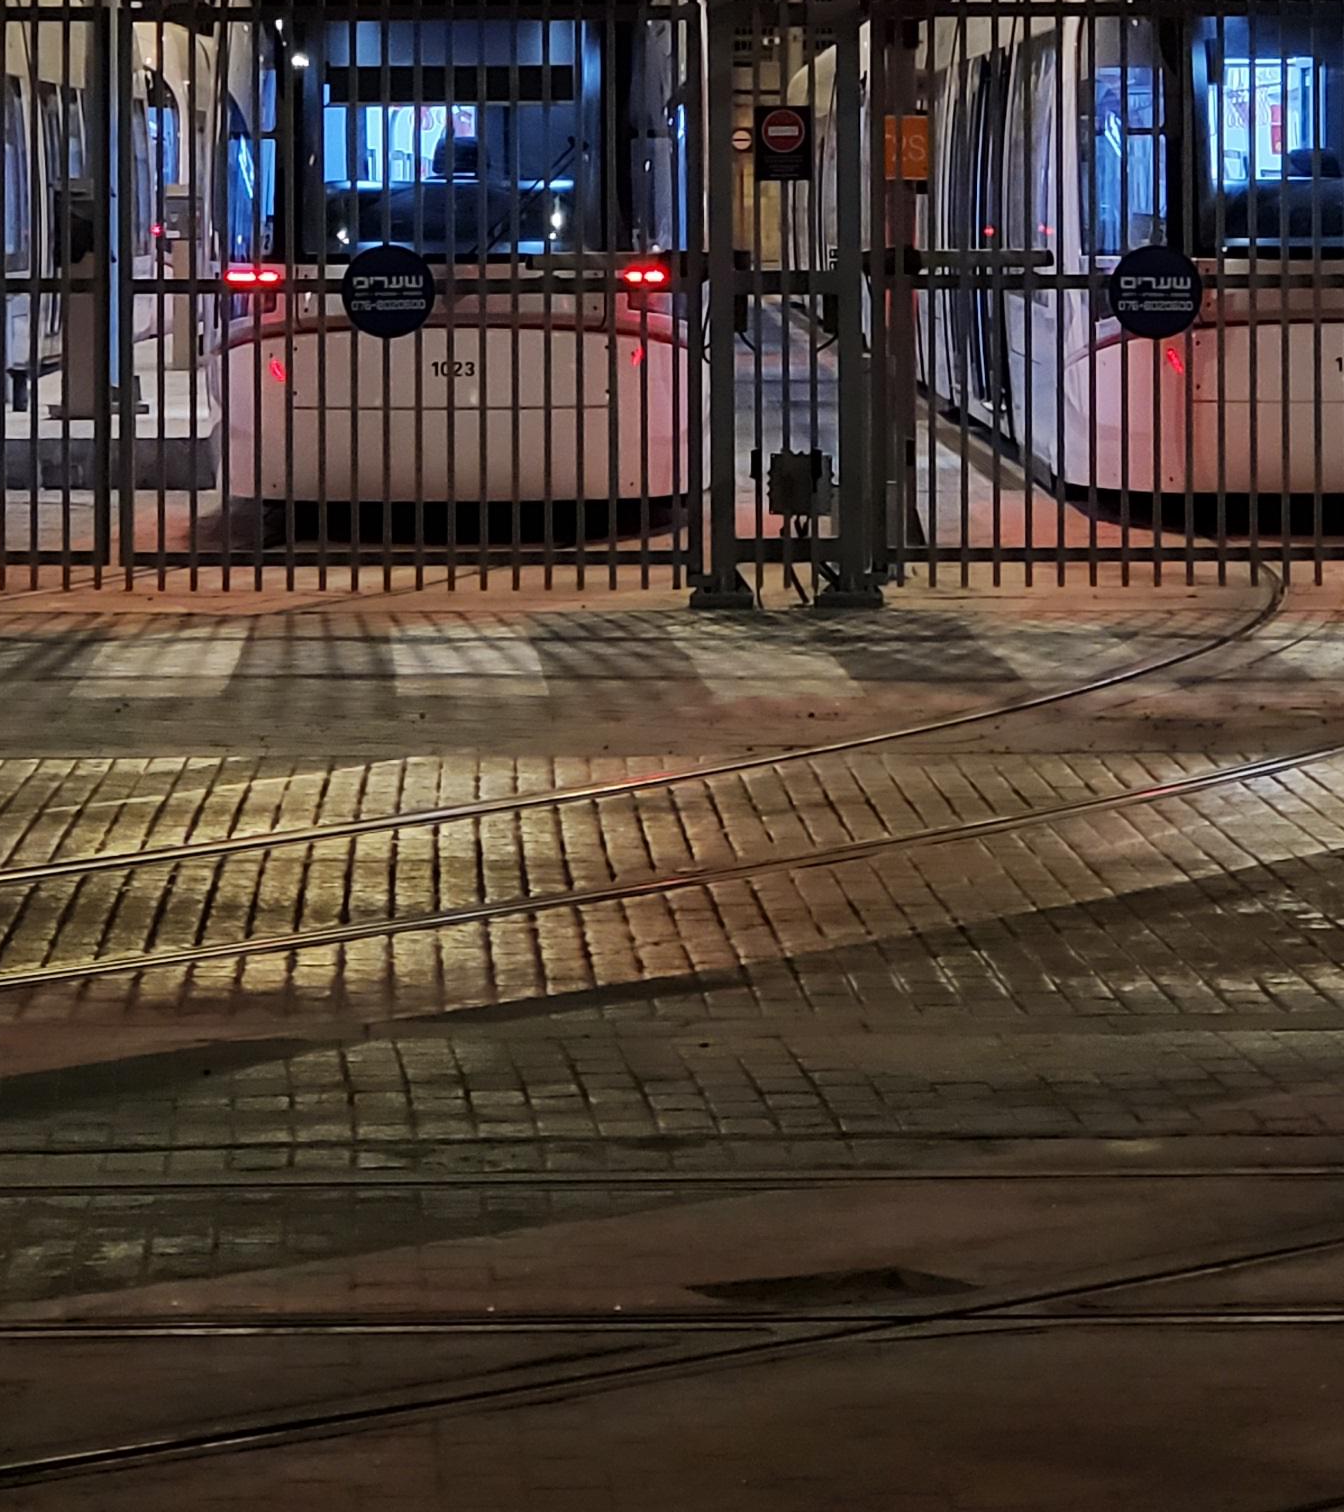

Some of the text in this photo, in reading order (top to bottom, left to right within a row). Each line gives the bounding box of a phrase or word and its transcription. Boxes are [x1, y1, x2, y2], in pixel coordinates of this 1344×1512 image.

[884, 135, 926, 161] 2S
[352, 275, 424, 289] שערים
[1120, 276, 1191, 289] שערים
[432, 361, 475, 377] 1023
